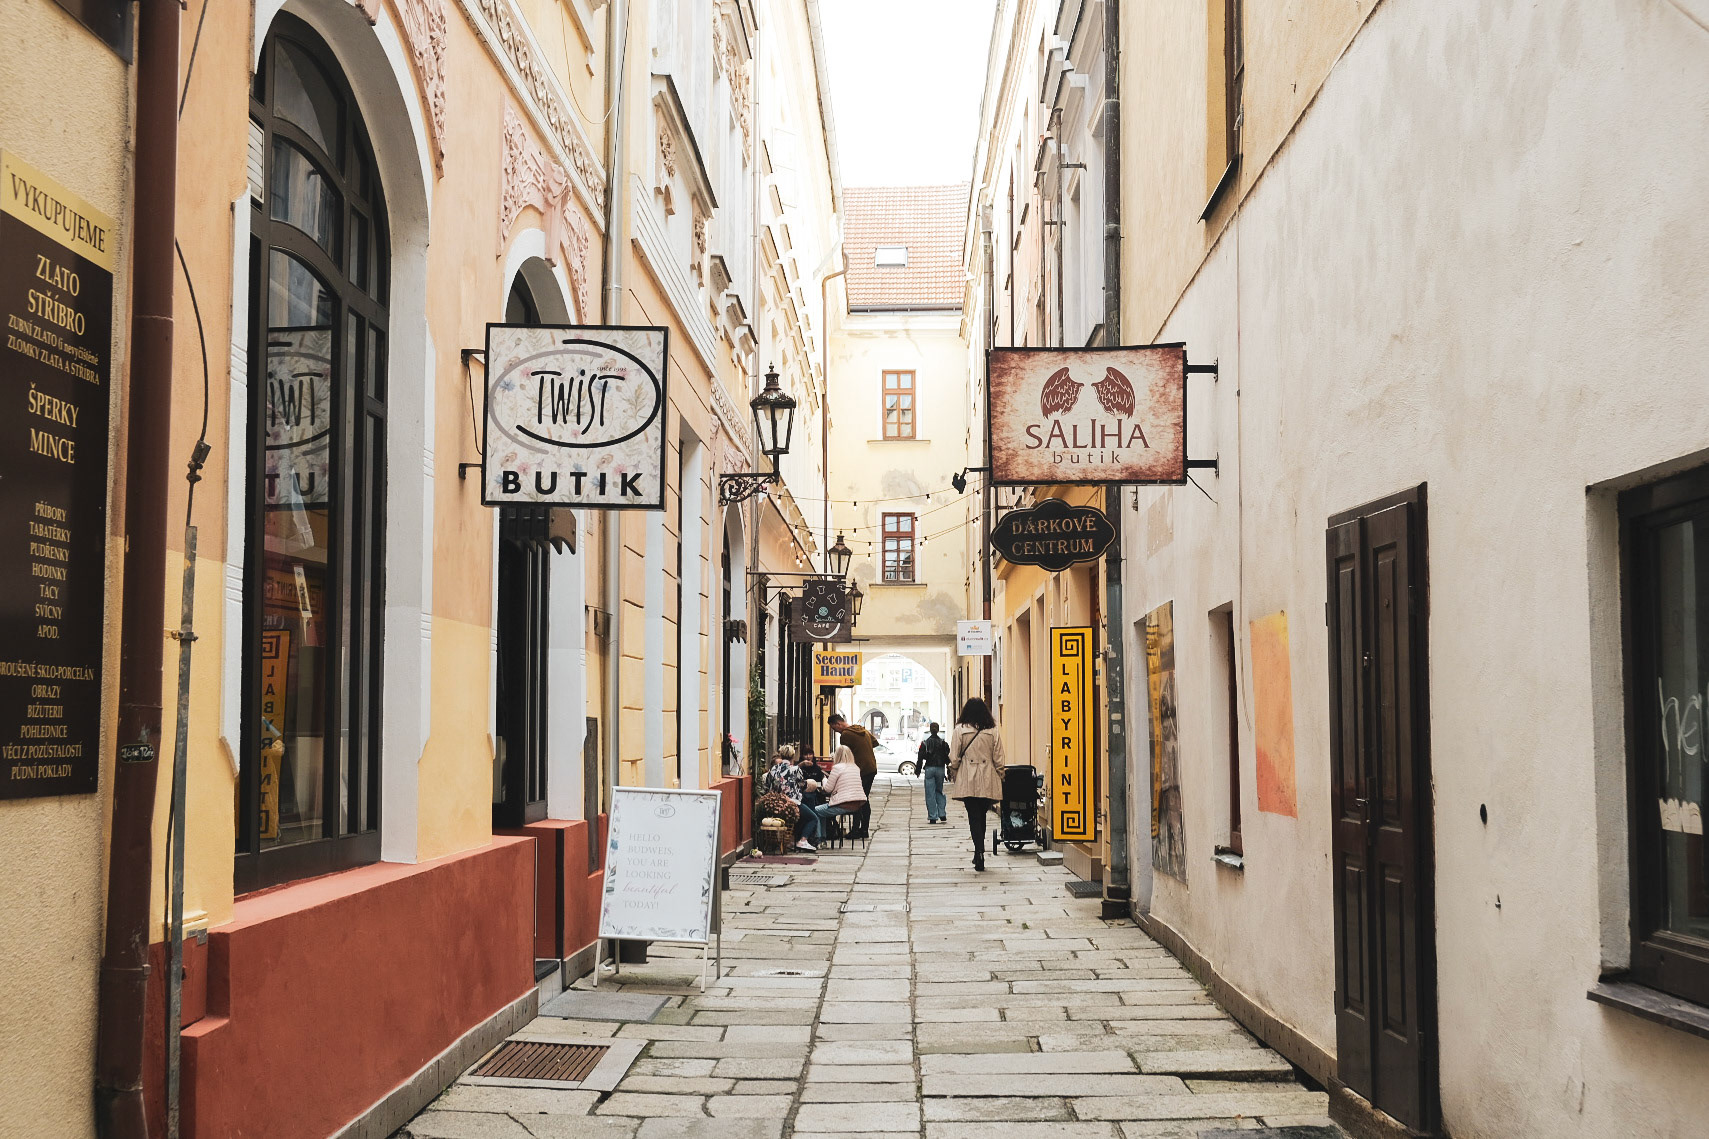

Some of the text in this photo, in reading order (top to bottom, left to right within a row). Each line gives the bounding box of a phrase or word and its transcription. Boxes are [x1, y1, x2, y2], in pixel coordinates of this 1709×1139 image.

[11, 172, 105, 253] VYKUPUJEME
[36, 254, 80, 296] ZLATO
[28, 289, 85, 336] STŘÍBRO
[8, 313, 33, 337] ZUBNÍ
[33, 325, 58, 347] ZLATO
[7, 334, 100, 386] ZLOMKY ZLATA A STŘÍBRA
[28, 382, 79, 428] ŠPERKY
[30, 428, 75, 464] MINCE
[1053, 451, 1121, 464] butik
[502, 470, 644, 497] BUTIK
[35, 500, 67, 522] PŘÍBORY
[29, 521, 71, 543] TABATÉRKY
[1012, 514, 1097, 535] DÁRKOVÉ
[30, 542, 70, 562] PUDŘENKY
[1012, 539, 1094, 555] CENTRUM
[32, 562, 68, 581] HODINKY
[40, 581, 59, 599] TÁCY
[37, 624, 60, 639] APOD.
[815, 654, 858, 665] Second
[37, 664, 95, 681] SKLO-PORCELÁN
[820, 665, 855, 677] Hand
[31, 684, 61, 698] OBRAZY
[27, 702, 63, 718] BIŽUTERII
[20, 725, 68, 738] POHLEDNICE
[1061, 663, 1072, 805] LABYRINT
[2, 742, 20, 759] VĚCI
[21, 745, 28, 759] Z
[38, 764, 73, 779] POKLADY
[629, 833, 661, 842] HELLO
[628, 845, 674, 856] BUDWEIS,
[627, 858, 669, 868] YOU ARE
[625, 870, 671, 880] LOOKING
[622, 881, 679, 900] beautiful
[623, 900, 660, 910] TODAY!
